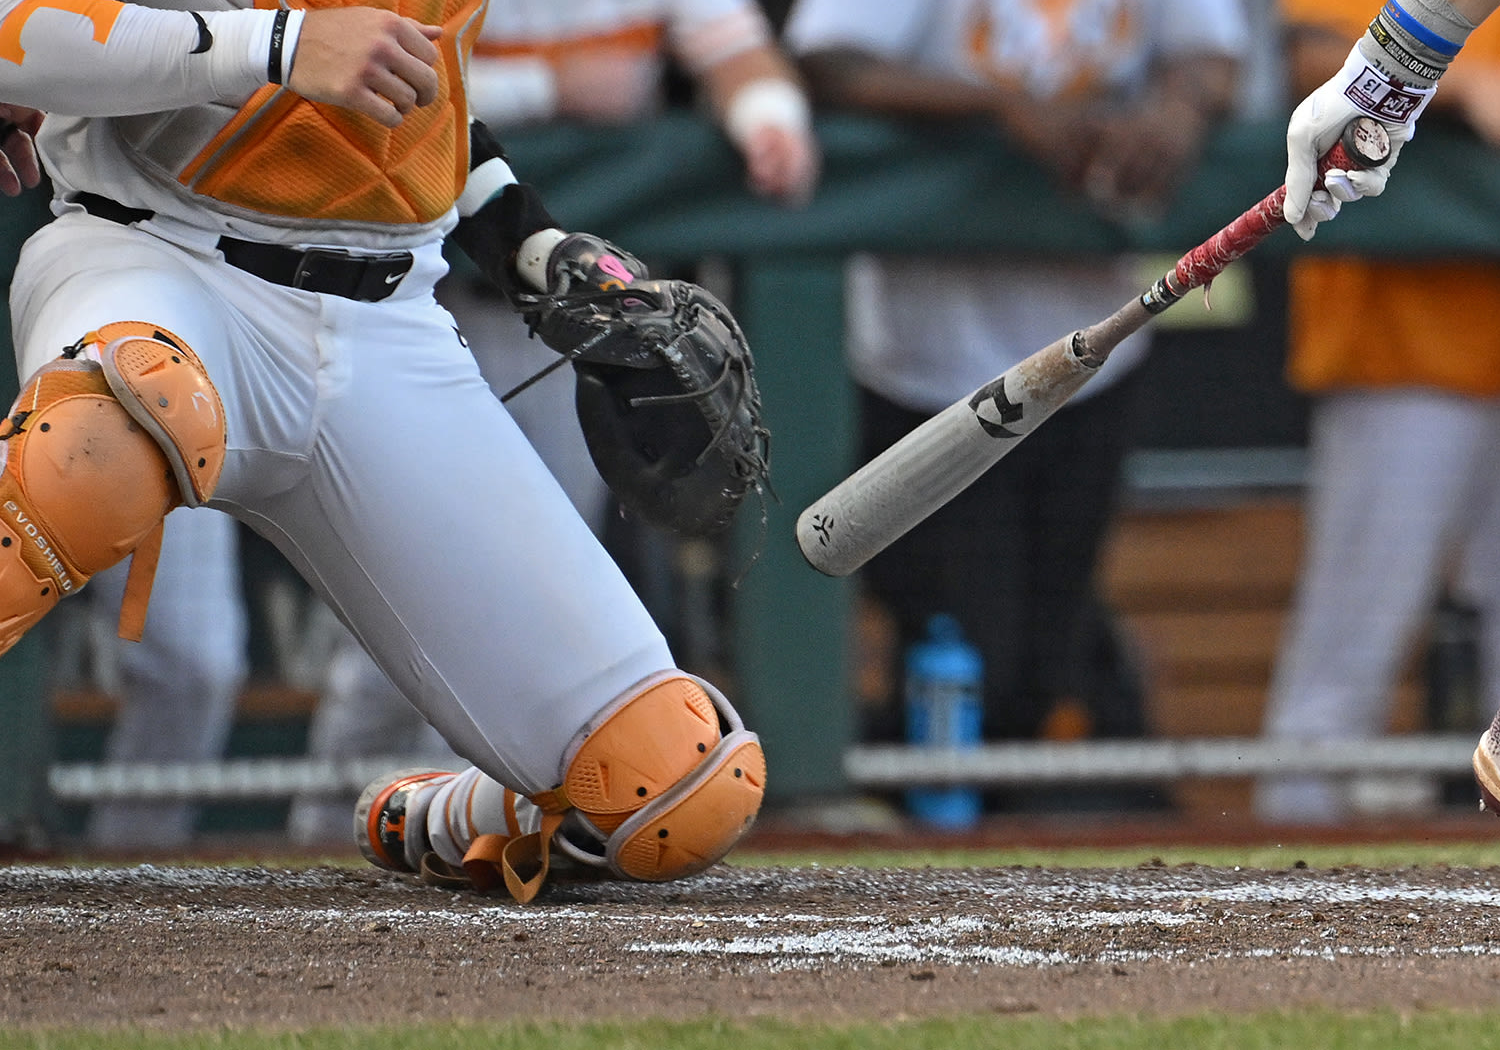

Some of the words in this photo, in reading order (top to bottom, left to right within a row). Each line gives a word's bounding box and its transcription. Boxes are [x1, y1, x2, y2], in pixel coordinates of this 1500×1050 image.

[1408, 59, 1424, 73] DO
[1420, 65, 1439, 80] CAN
[1362, 78, 1382, 95] 13
